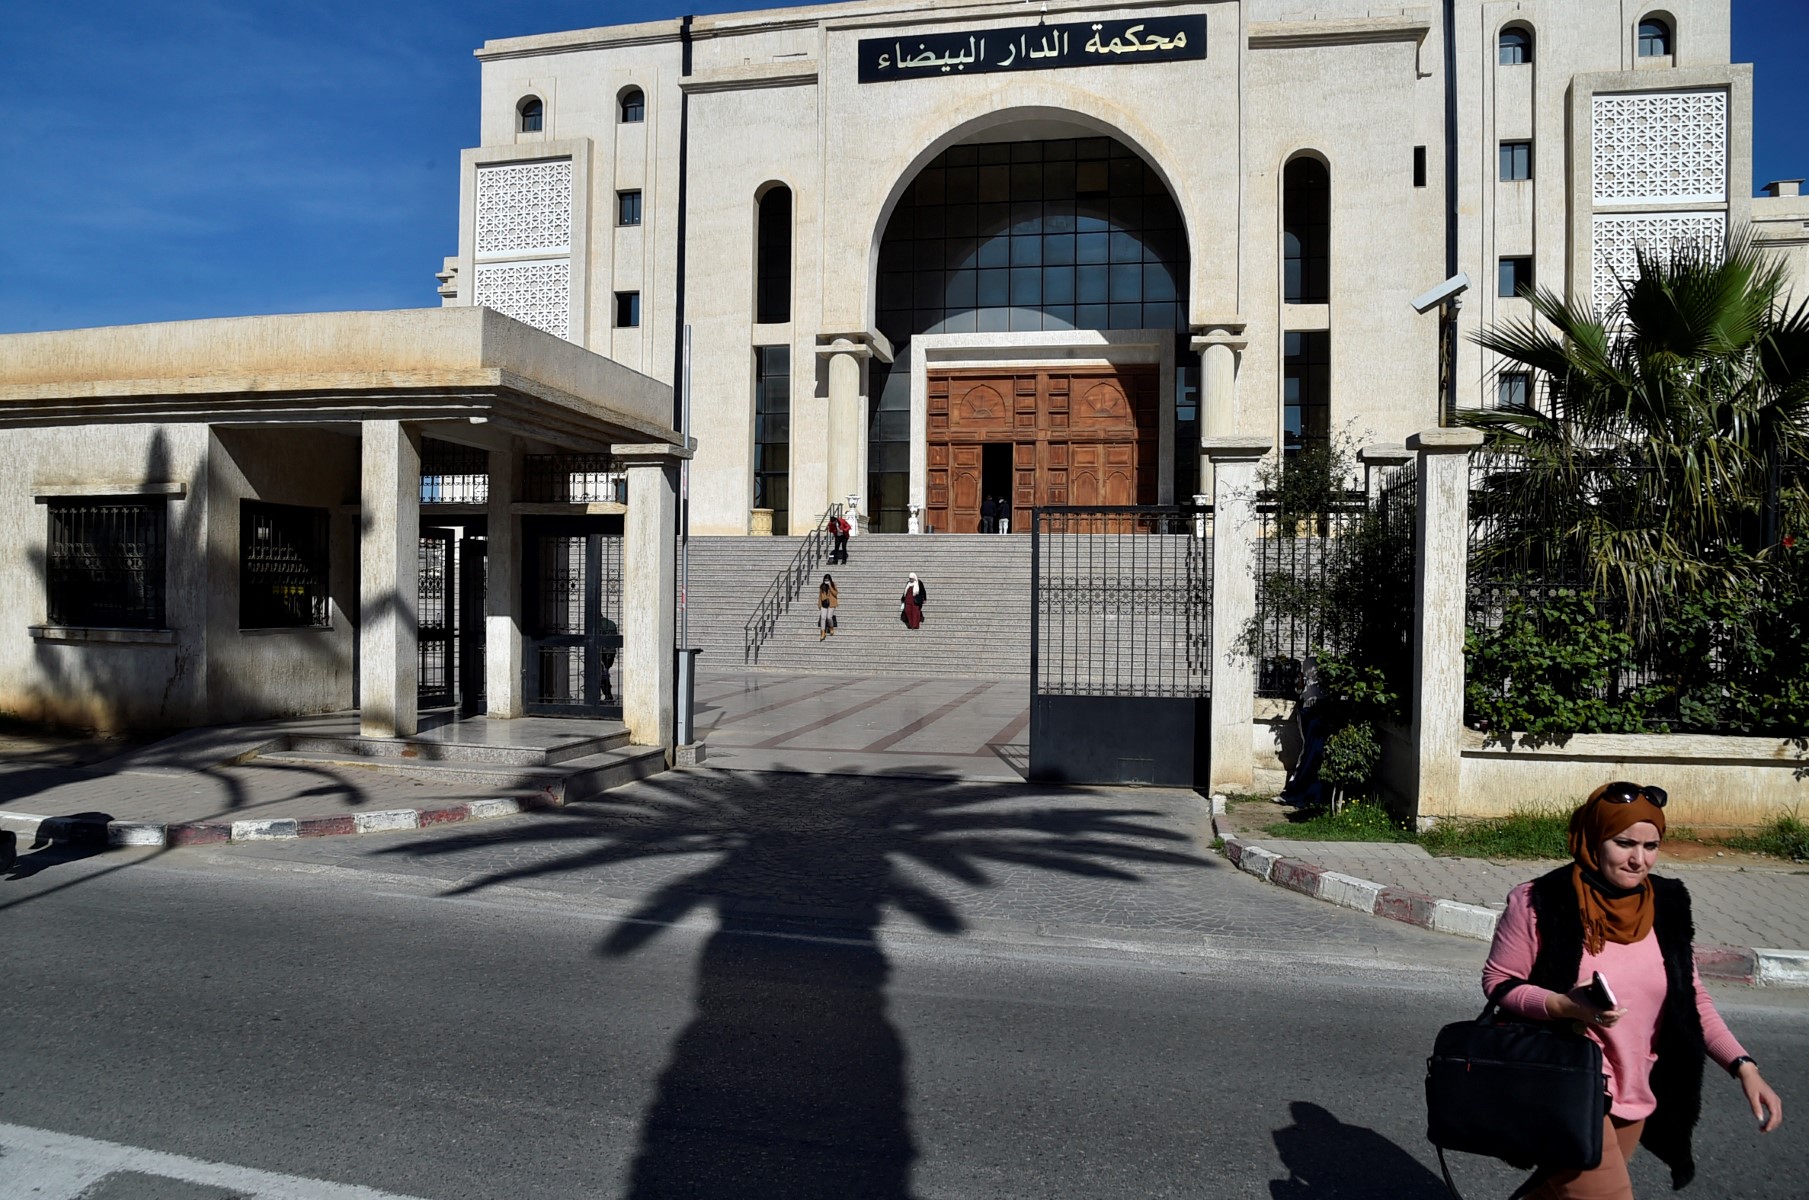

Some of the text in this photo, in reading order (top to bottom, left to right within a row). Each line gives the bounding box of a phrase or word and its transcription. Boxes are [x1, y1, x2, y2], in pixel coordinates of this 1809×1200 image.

[877, 24, 1188, 72] محكمة الدار البيضاء
